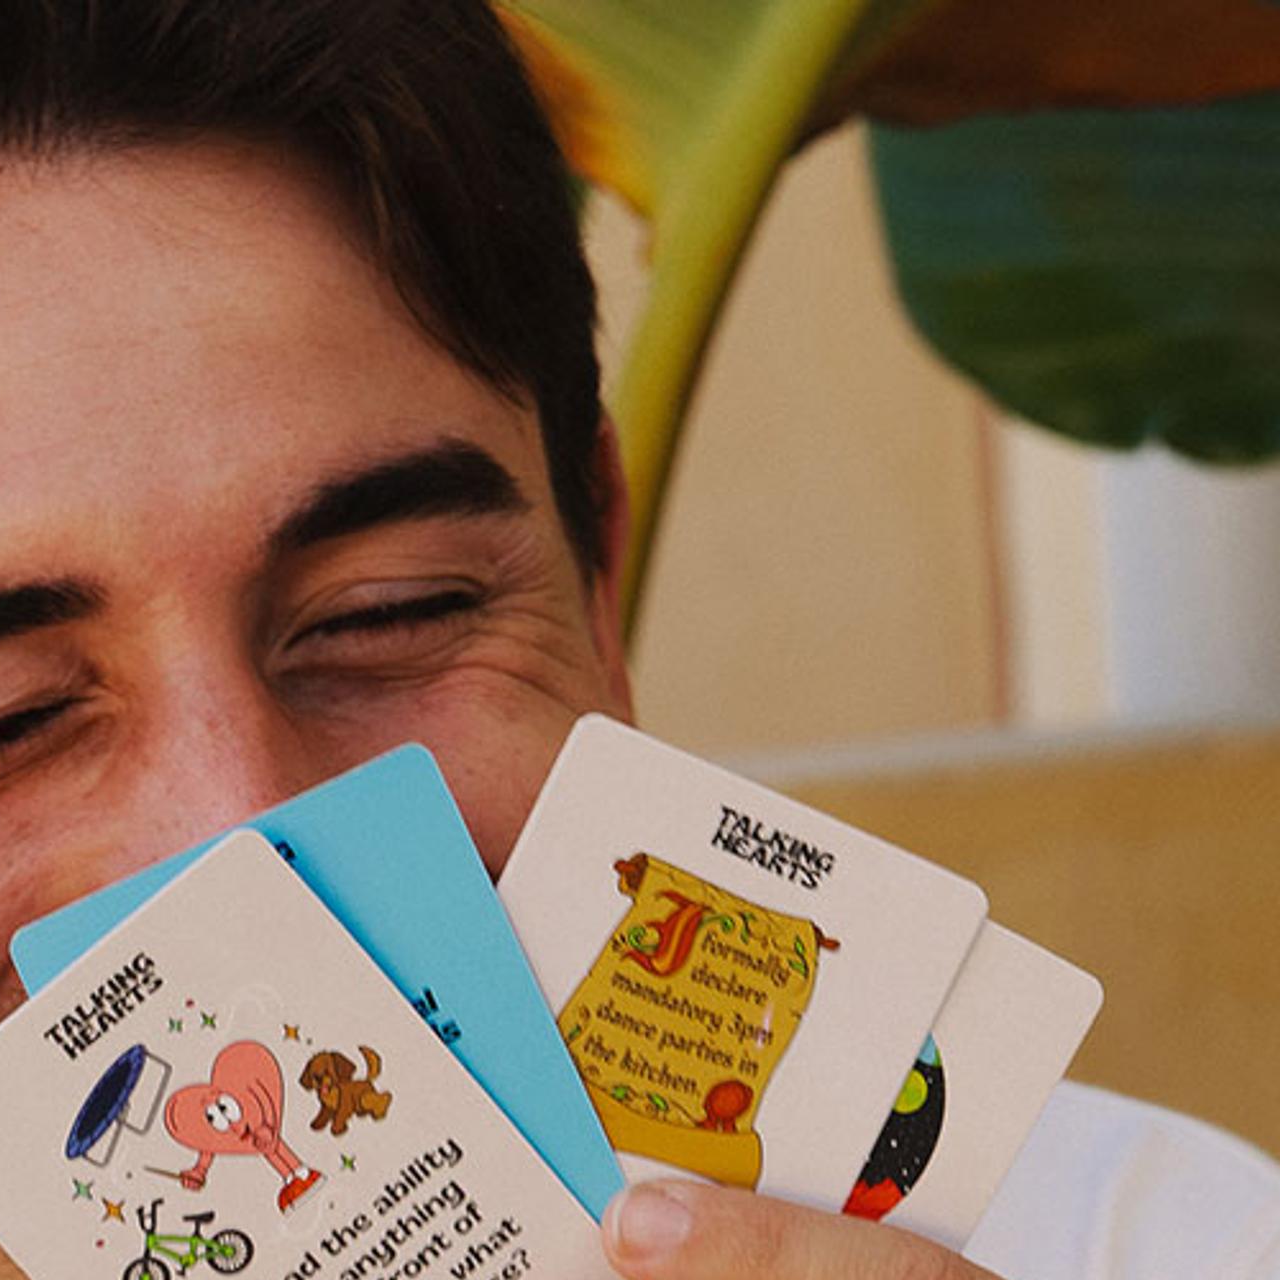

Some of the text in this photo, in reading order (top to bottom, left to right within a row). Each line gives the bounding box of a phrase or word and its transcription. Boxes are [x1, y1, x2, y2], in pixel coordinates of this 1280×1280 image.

[711, 827, 821, 890] HEARTS
[721, 803, 835, 874] TALKING
[689, 961, 769, 1006] declare
[700, 930, 792, 988] formally
[43, 951, 155, 1045] TALKING
[62, 970, 164, 1061] HEARTS
[610, 970, 774, 1045] mandatory 3pm
[582, 1033, 618, 1065] the
[596, 999, 759, 1078] dance parties in
[320, 1215, 373, 1258] the
[372, 1137, 464, 1217] ability
[452, 1201, 485, 1237] of
